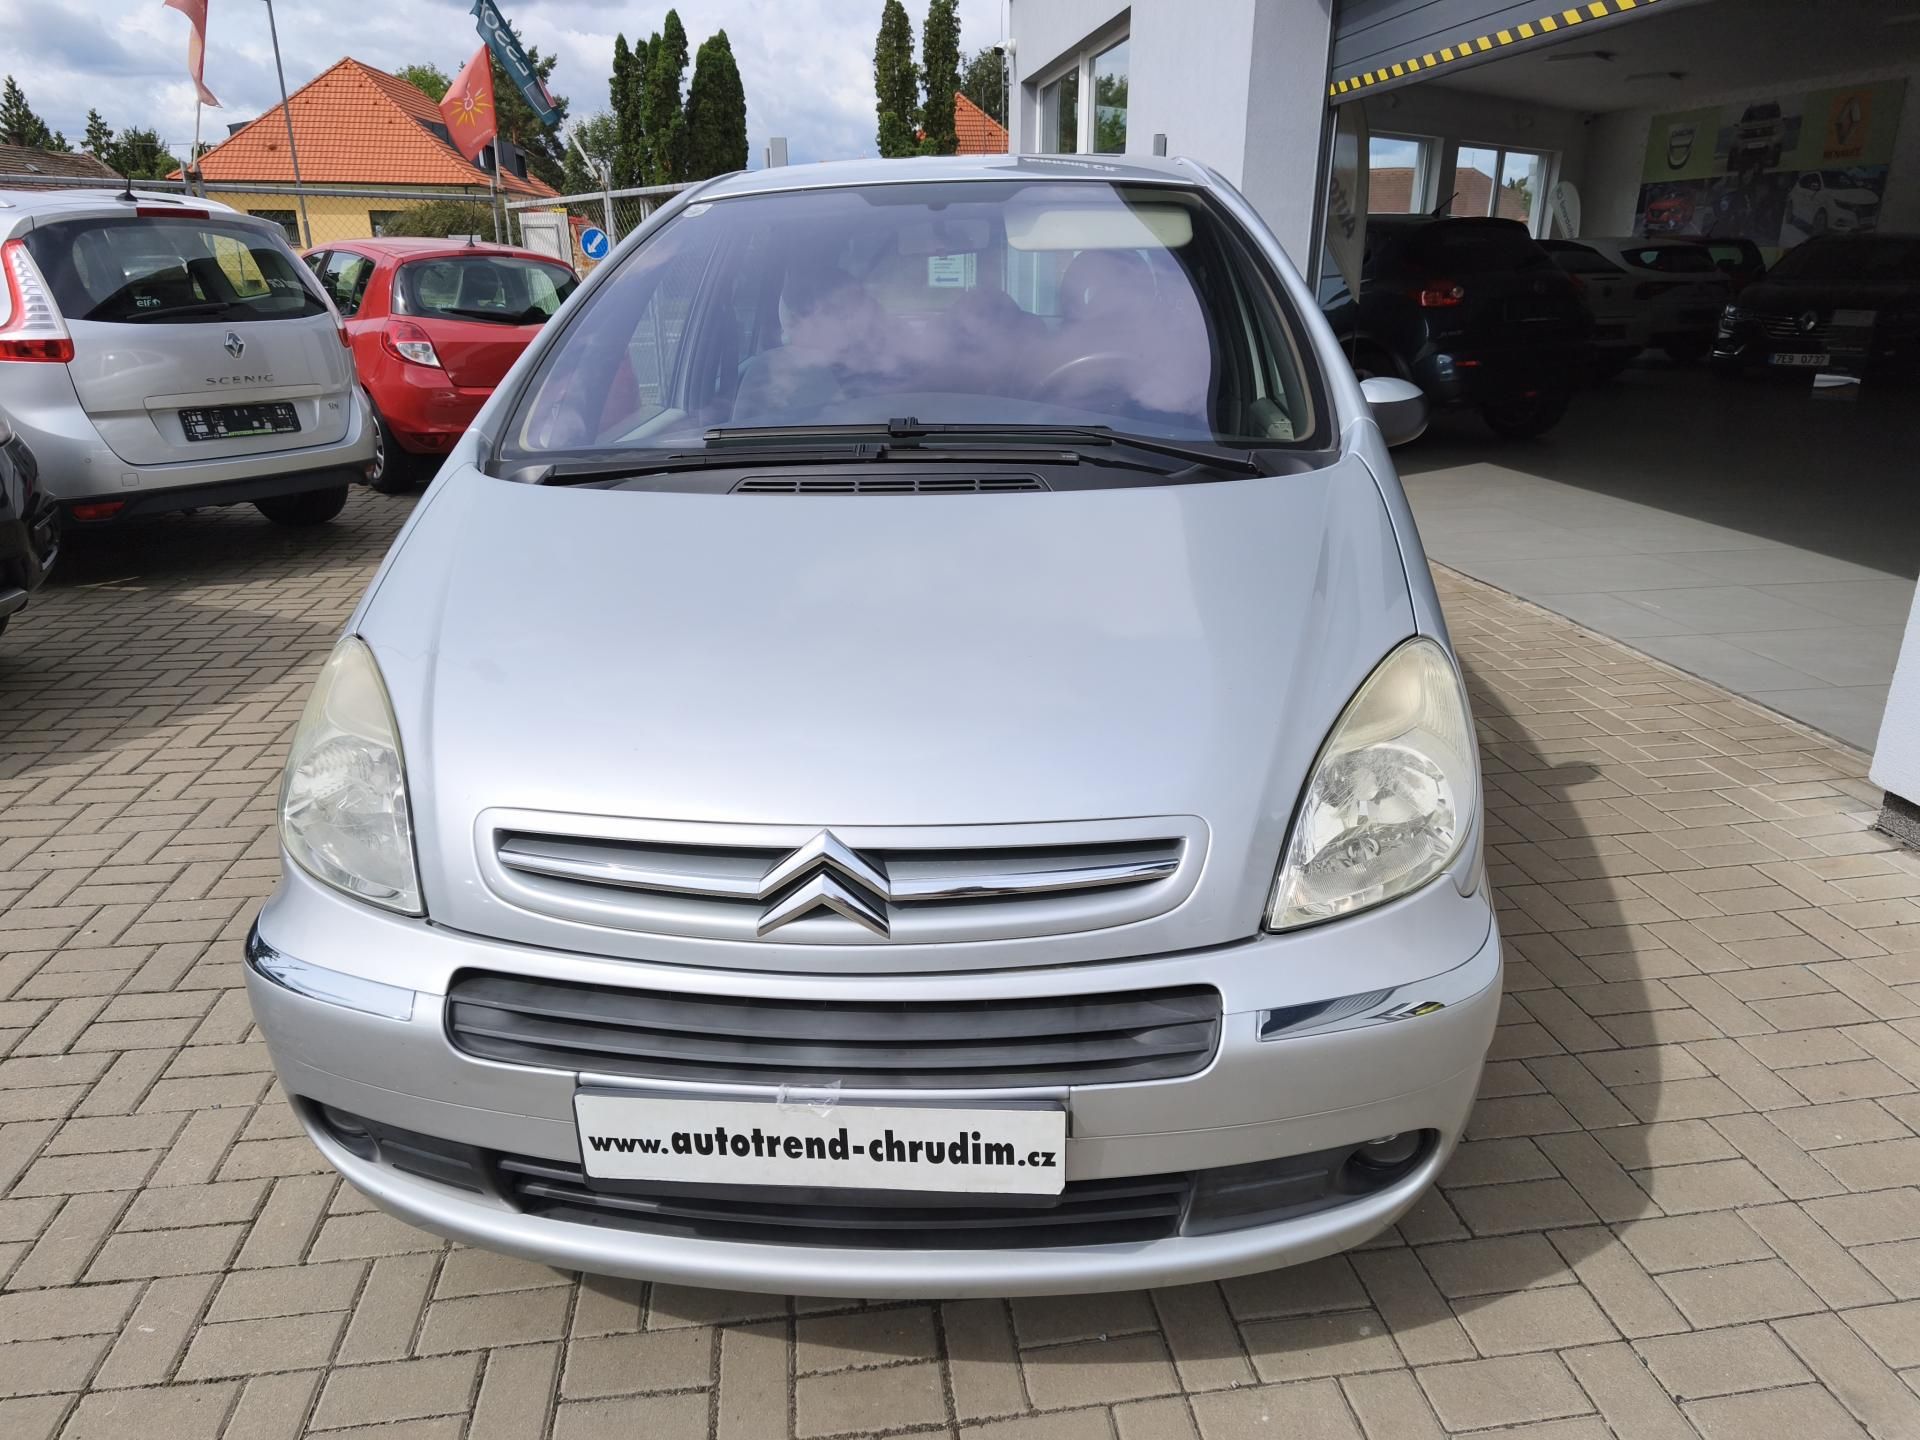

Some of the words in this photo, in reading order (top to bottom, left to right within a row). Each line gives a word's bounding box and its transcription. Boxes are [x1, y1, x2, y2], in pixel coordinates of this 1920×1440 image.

[136, 299, 152, 307] elf
[1775, 354, 1794, 364] 7E9
[206, 374, 274, 386] SCENIC
[588, 1127, 1057, 1168] www.autotrend-chrudim.cz
